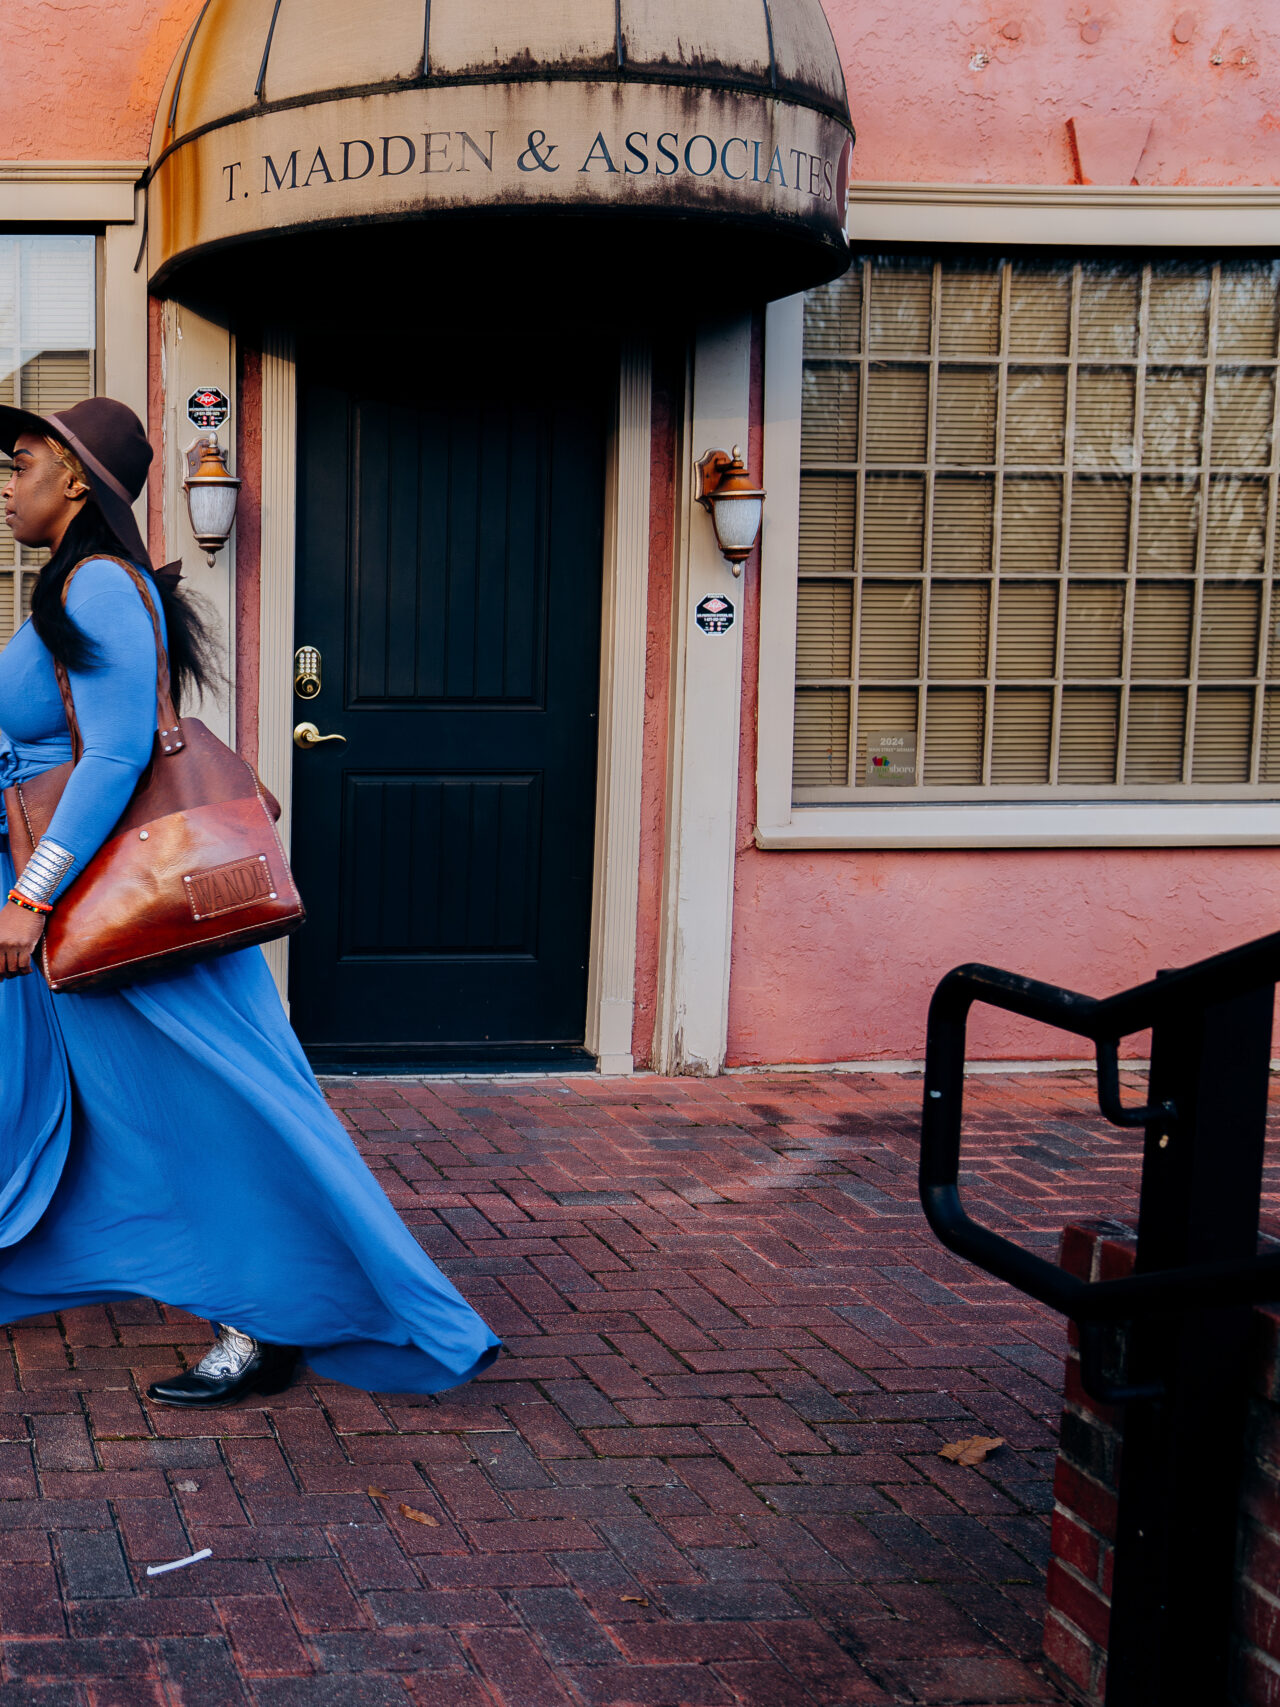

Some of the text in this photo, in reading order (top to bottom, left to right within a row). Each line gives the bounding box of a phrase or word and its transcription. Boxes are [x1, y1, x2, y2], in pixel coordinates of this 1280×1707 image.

[222, 129, 833, 203] T. MADDEN & ASSOCIATES
[880, 737, 904, 746] 2024
